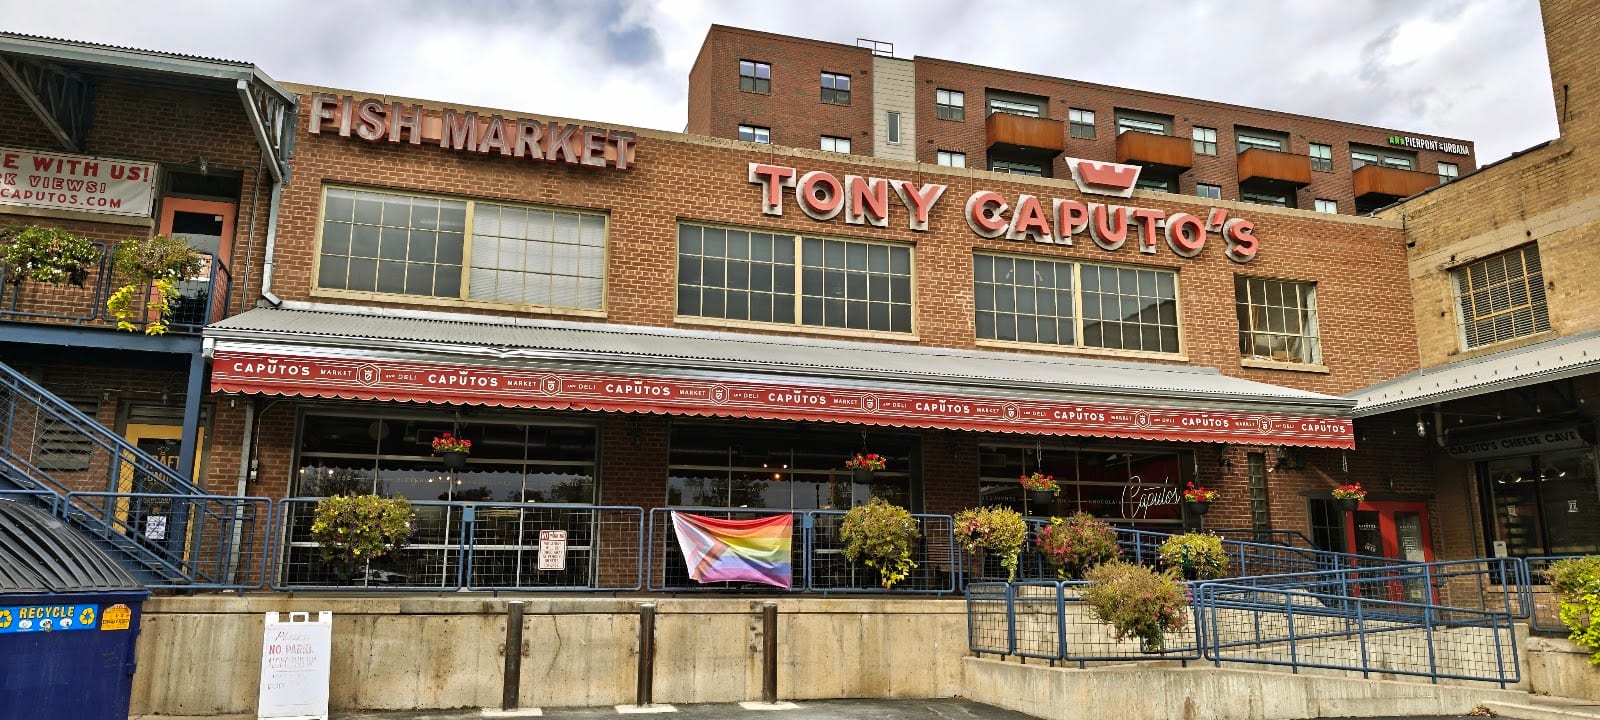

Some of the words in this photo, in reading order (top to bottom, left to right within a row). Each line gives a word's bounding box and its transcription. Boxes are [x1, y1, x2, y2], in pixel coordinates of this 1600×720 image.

[308, 91, 424, 145] FISH
[440, 107, 637, 170] MARKET
[1404, 136, 1438, 151] PIERPONT
[1443, 142, 1470, 155] URBANA
[32, 155, 99, 177] WITH
[110, 164, 150, 183] US!
[0, 172, 18, 186] K
[29, 174, 107, 194] VIEWS!
[0, 188, 122, 209] CAPUTOS.COM
[750, 163, 946, 229] TONY
[967, 190, 1259, 263] CAPUTO'S
[233, 360, 310, 376] CAPUTO'S
[320, 368, 352, 377] MARKET
[428, 372, 498, 387] CAPUTO'S
[605, 382, 671, 396] CAPUTO'S
[767, 391, 827, 405] CAPUTO'S
[915, 401, 970, 414] CAPUTO'S
[1053, 410, 1105, 422] CAPUTO'S
[1181, 416, 1230, 428] CAPUTO'S
[1301, 423, 1346, 433] CAPUTO'S
[1450, 441, 1498, 455] CAPUTO'S
[1501, 435, 1542, 449] CHEESE
[1545, 431, 1578, 443] CAVE
[19, 606, 75, 619] RECYCLE
